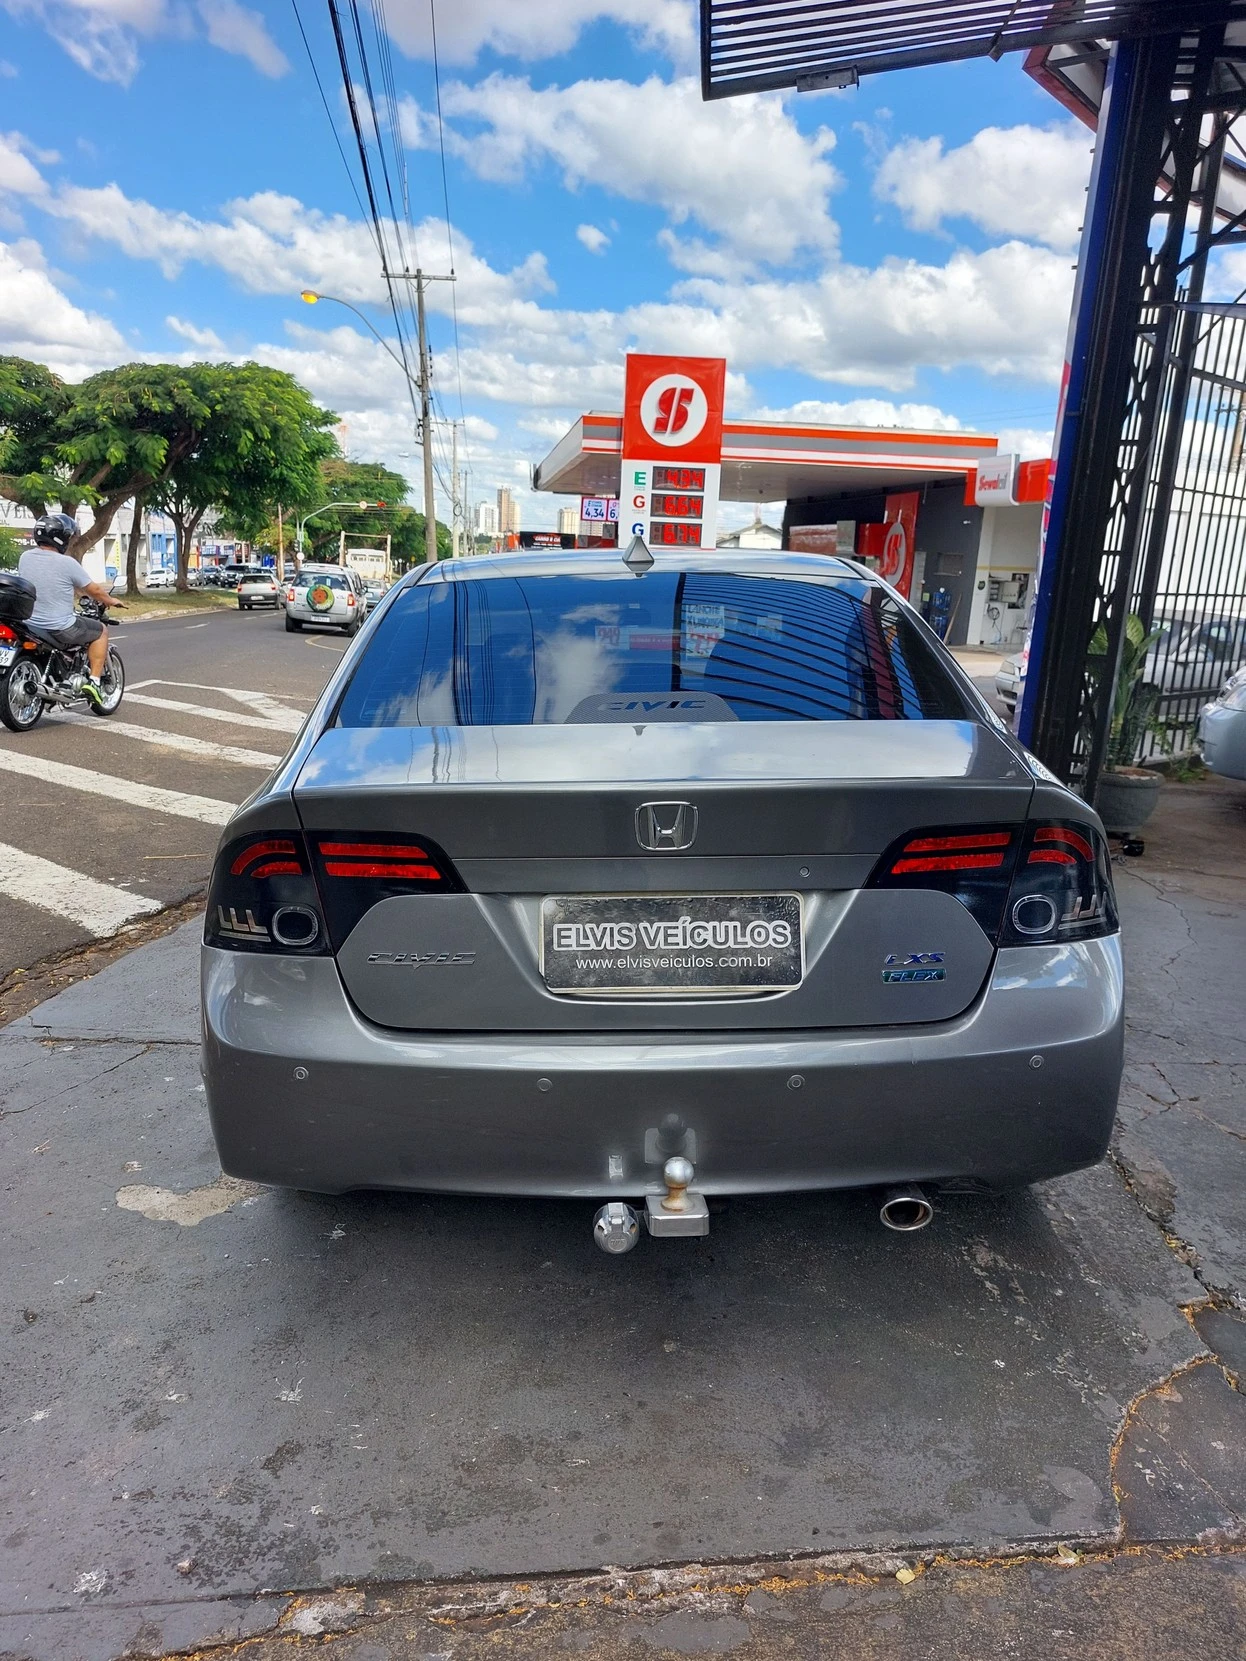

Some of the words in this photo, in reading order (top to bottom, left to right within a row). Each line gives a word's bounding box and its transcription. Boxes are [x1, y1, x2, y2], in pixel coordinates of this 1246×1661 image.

[634, 471, 646, 486] E
[632, 494, 646, 509] G
[585, 508, 604, 518] 4,34
[598, 700, 706, 712] CIVIC
[552, 921, 637, 951] ELVIS
[639, 916, 792, 950] VEÍCULOS
[366, 952, 477, 970] CIVIC
[575, 953, 773, 970] www.elvisveiculos.com.br
[883, 951, 946, 966] LXS
[887, 970, 939, 983] FLEX
